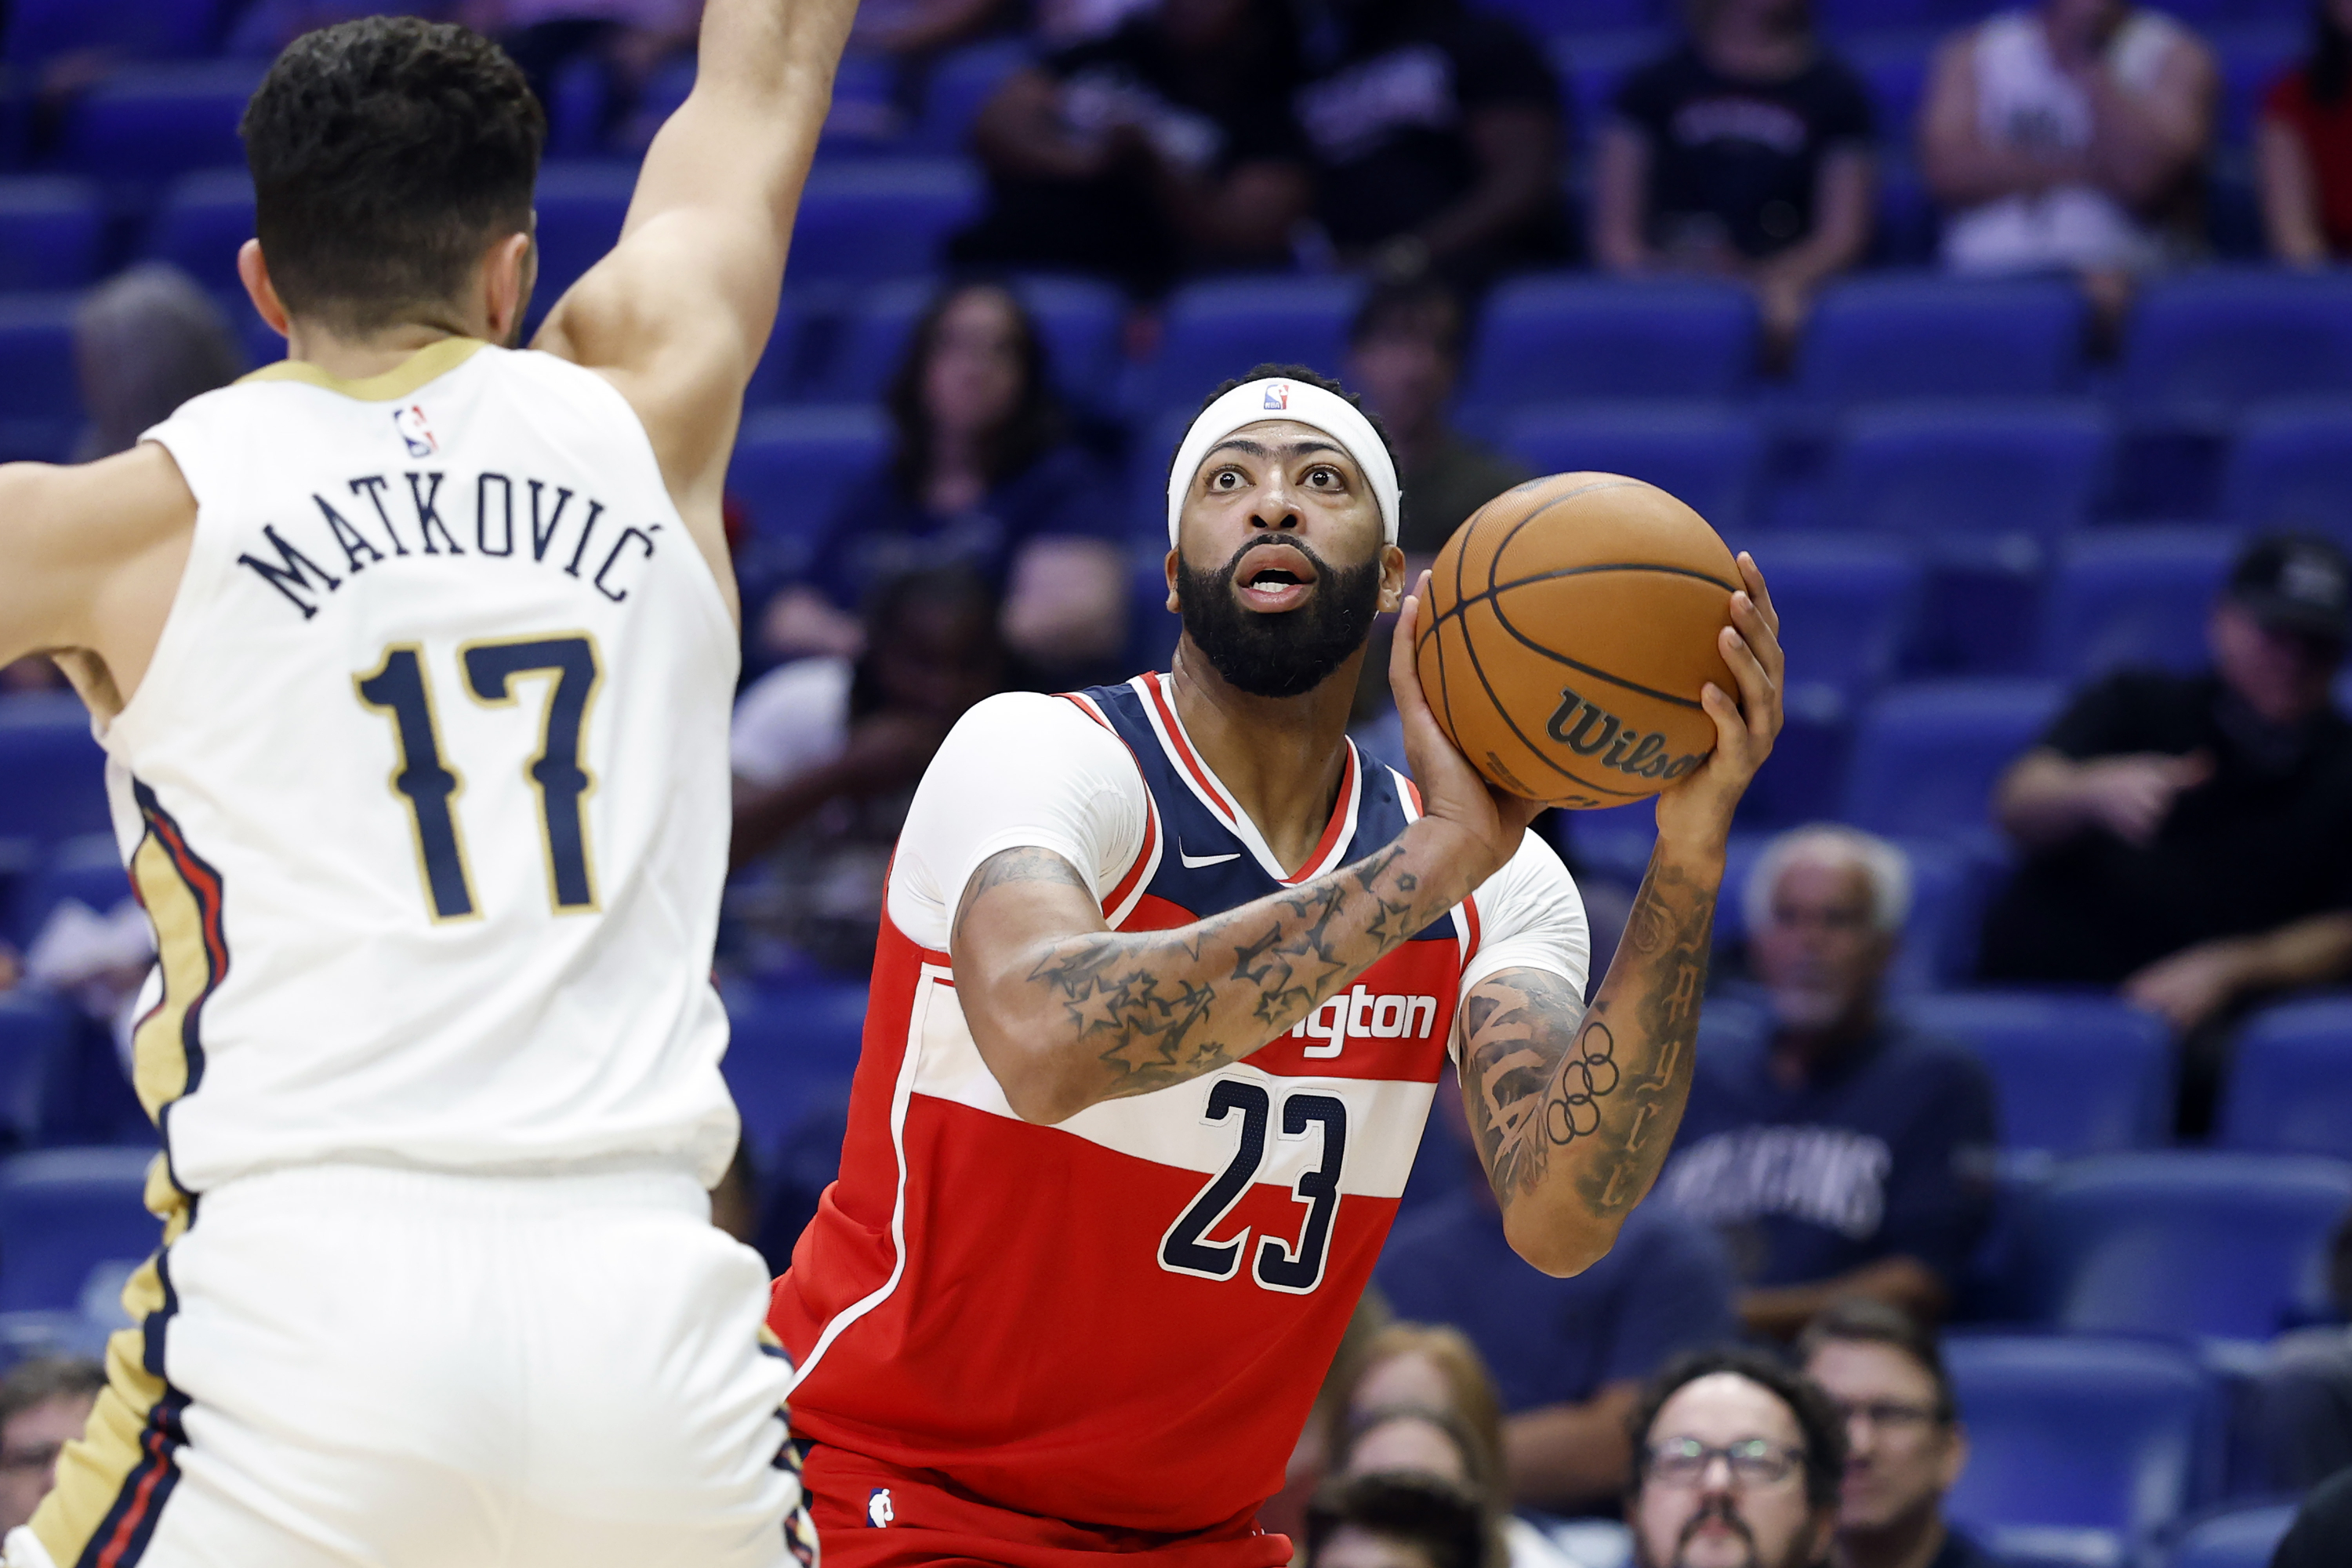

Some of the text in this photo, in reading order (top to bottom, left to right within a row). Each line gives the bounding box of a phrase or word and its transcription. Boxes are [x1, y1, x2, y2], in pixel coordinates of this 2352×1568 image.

[238, 472, 664, 620] MATKOVIĆ
[350, 630, 605, 926] 17
[1545, 687, 1708, 779] Wilso
[1291, 984, 1437, 1058] gton
[1156, 1072, 1352, 1295] 23
